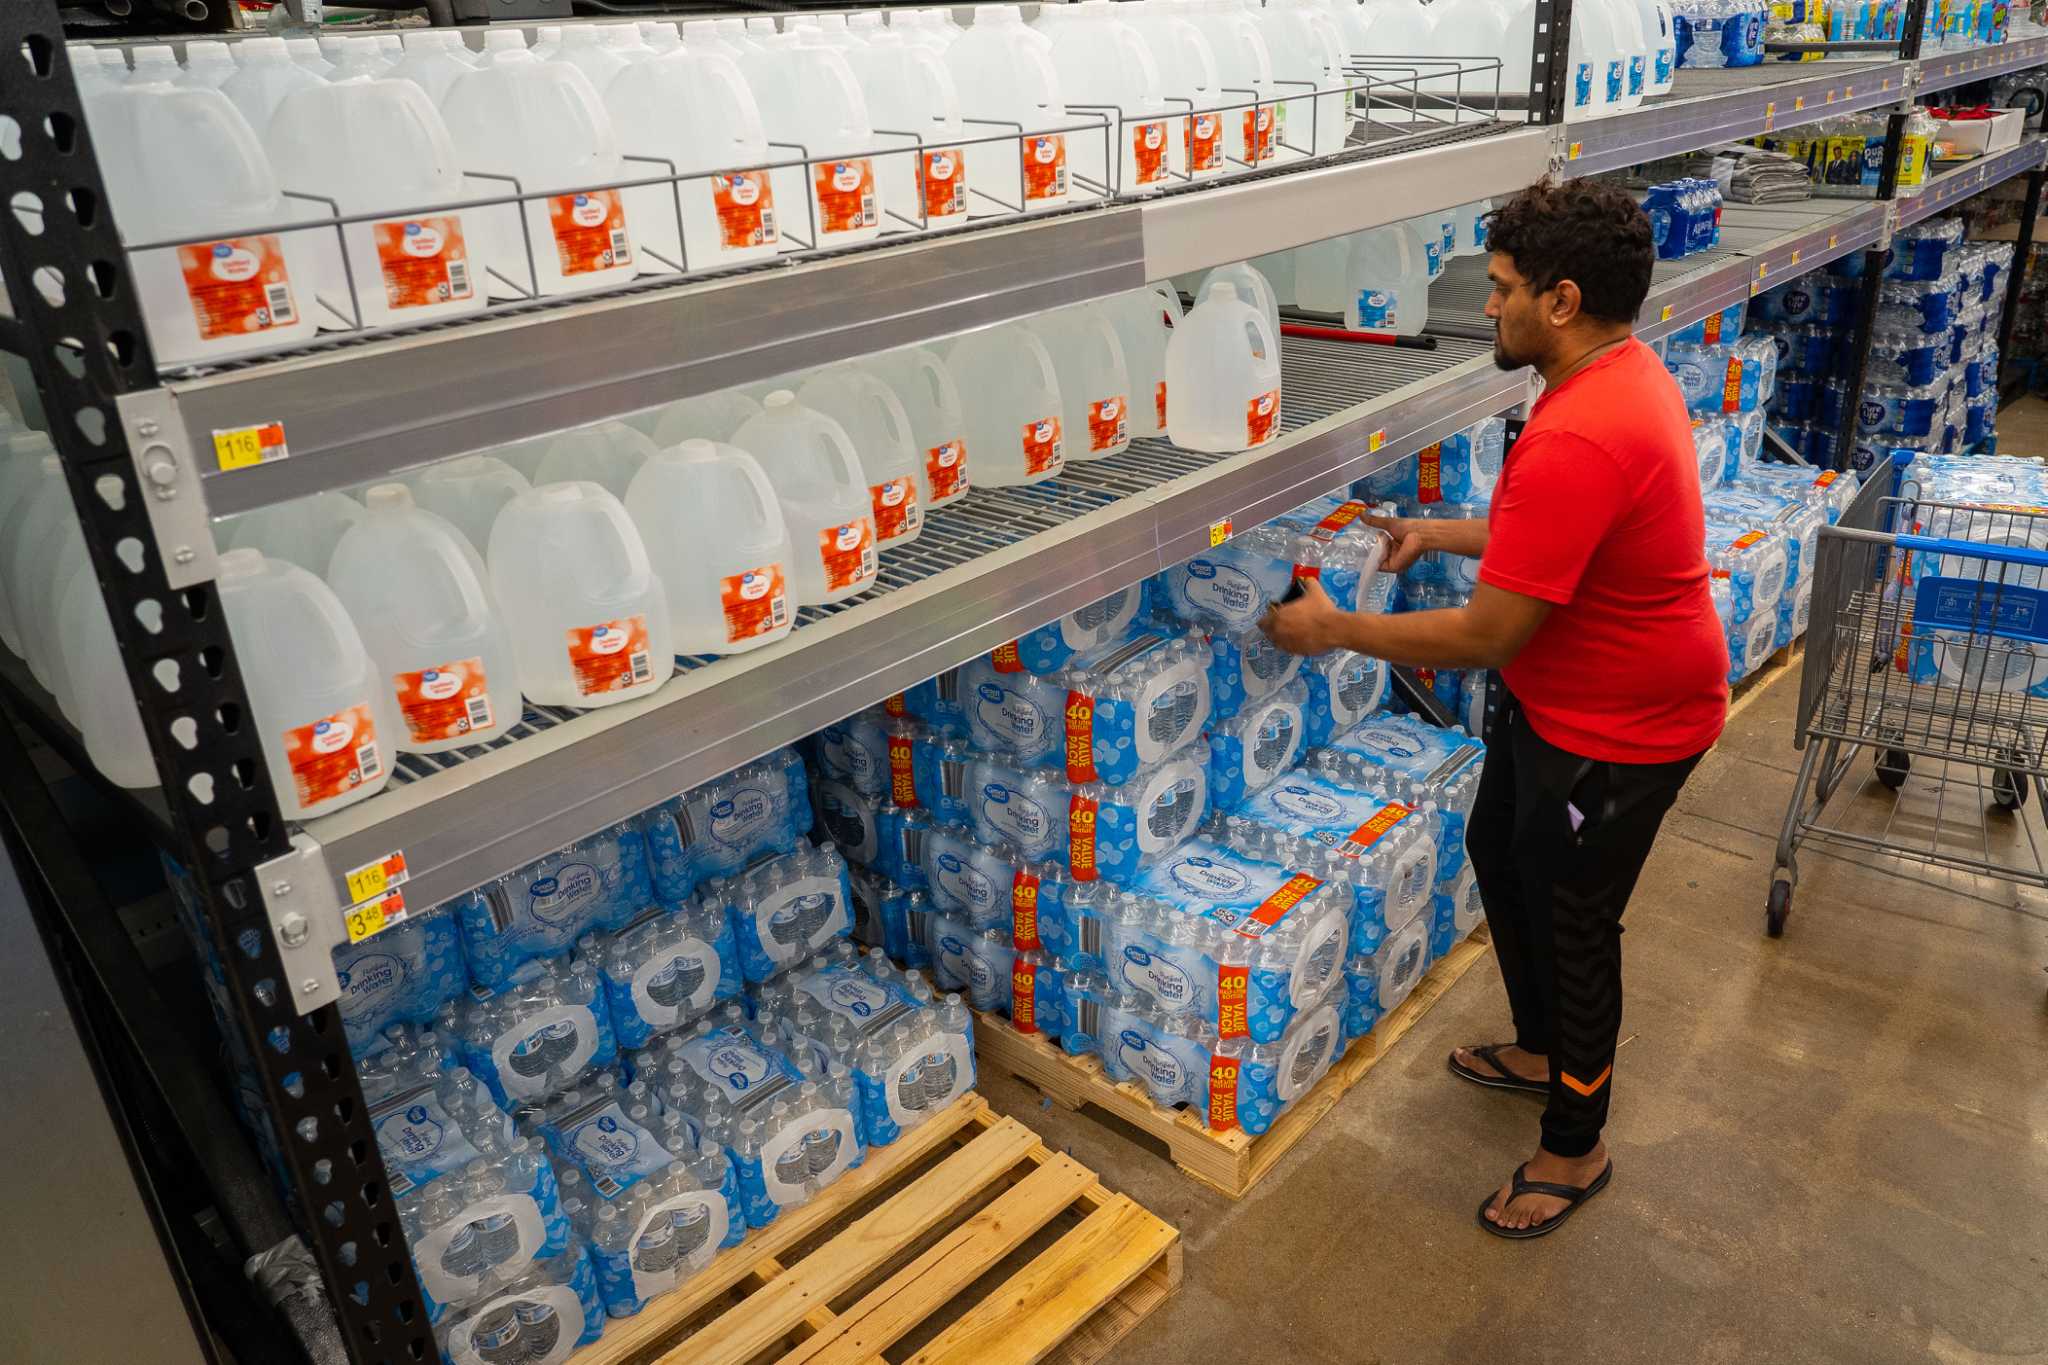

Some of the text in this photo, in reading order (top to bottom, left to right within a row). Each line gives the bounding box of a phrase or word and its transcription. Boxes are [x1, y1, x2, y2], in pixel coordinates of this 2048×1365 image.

[1212, 583, 1250, 602] Drinking
[1223, 595, 1249, 609] Water
[1066, 705, 1091, 720] 40
[890, 747, 911, 760] 40
[1067, 736, 1079, 768] PACK
[1078, 734, 1091, 768] VALUE
[1071, 810, 1094, 823] 40
[1071, 838, 1081, 868] PACK
[1081, 836, 1093, 869] VALUE
[1014, 885, 1036, 898] 40
[351, 968, 392, 995] Drinking
[1014, 972, 1033, 986] 40
[1148, 970, 1183, 993] Drinking
[1220, 976, 1246, 989] 40
[1220, 1004, 1233, 1034] PACK
[1233, 1002, 1246, 1032] VALUE
[1142, 1055, 1176, 1078] Drinking
[1211, 1067, 1237, 1080] 40
[1211, 1093, 1223, 1121] PACK
[1223, 1092, 1235, 1121] VALUE
